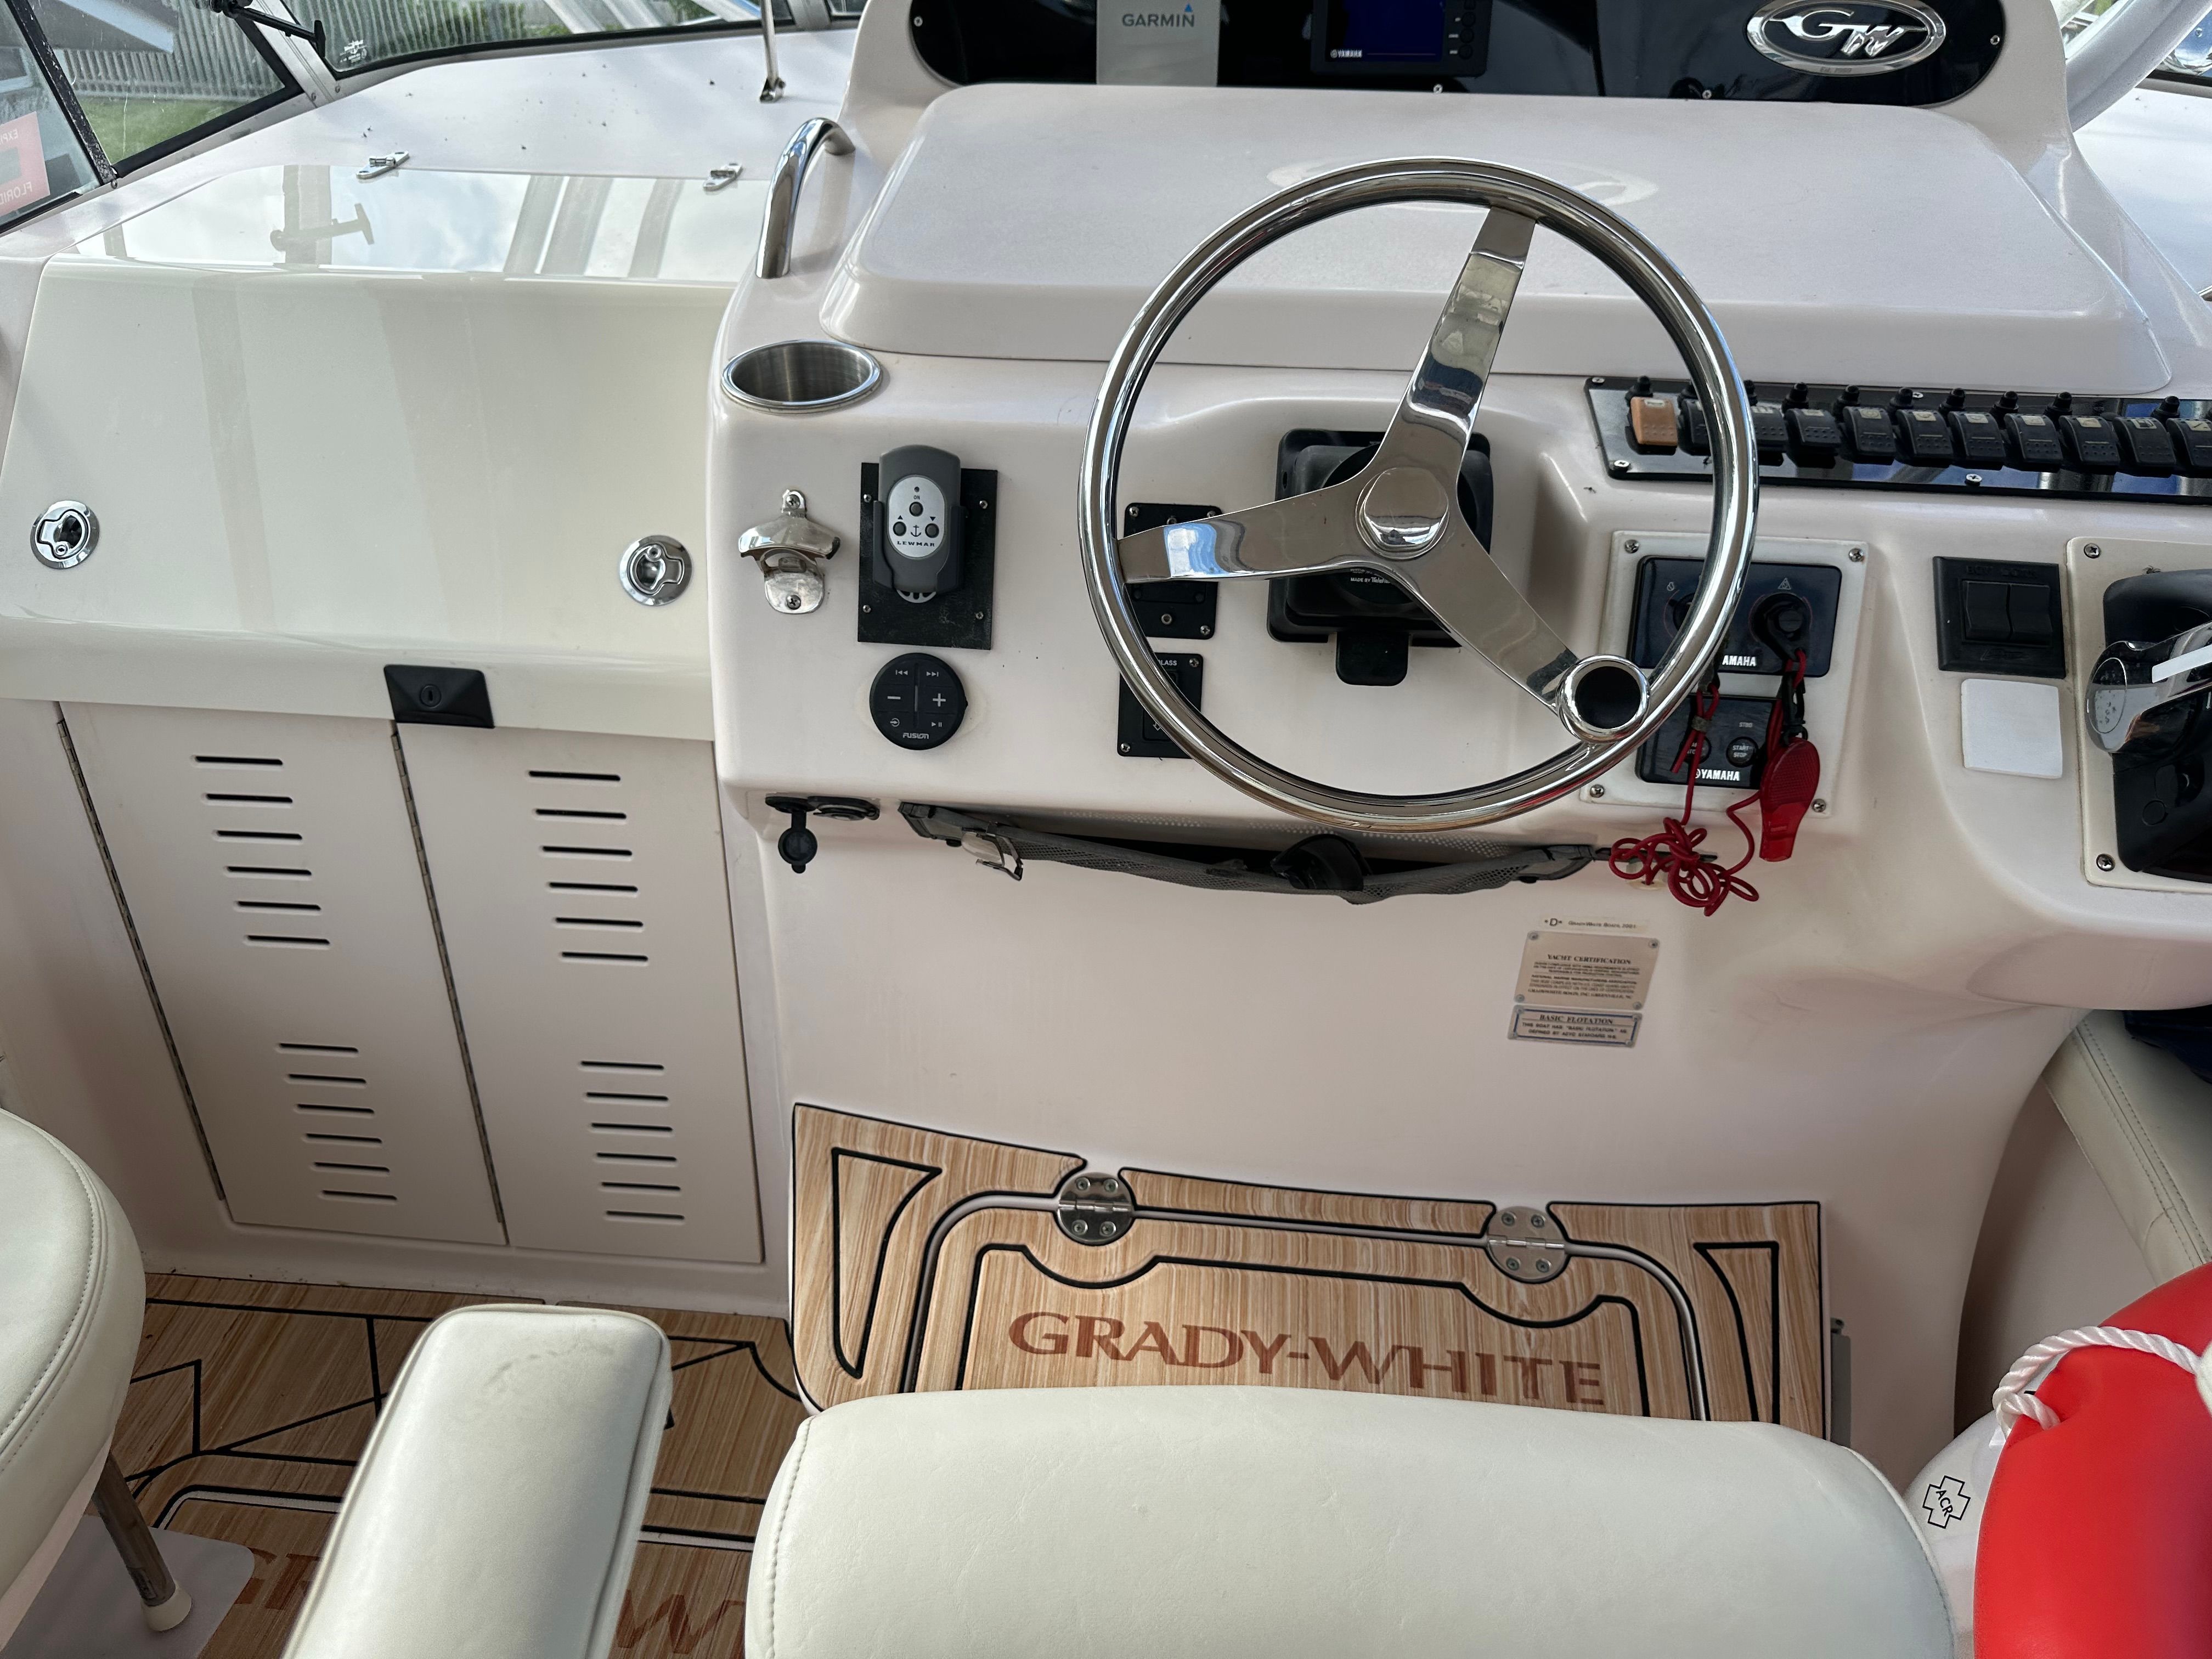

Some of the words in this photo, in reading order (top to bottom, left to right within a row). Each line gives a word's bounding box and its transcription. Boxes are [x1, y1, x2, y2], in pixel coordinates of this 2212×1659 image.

[1122, 13, 1195, 27] GARMIN
[1722, 654, 1757, 667] AMAHA
[1701, 769, 1740, 781] YAMAHA
[1573, 956, 1632, 965] CERTIFICATION
[1567, 1016, 1613, 1024] FLOTATION
[1008, 1310, 1605, 1406] GRADY-WHITE
[1936, 1490, 1953, 1517] ACR
